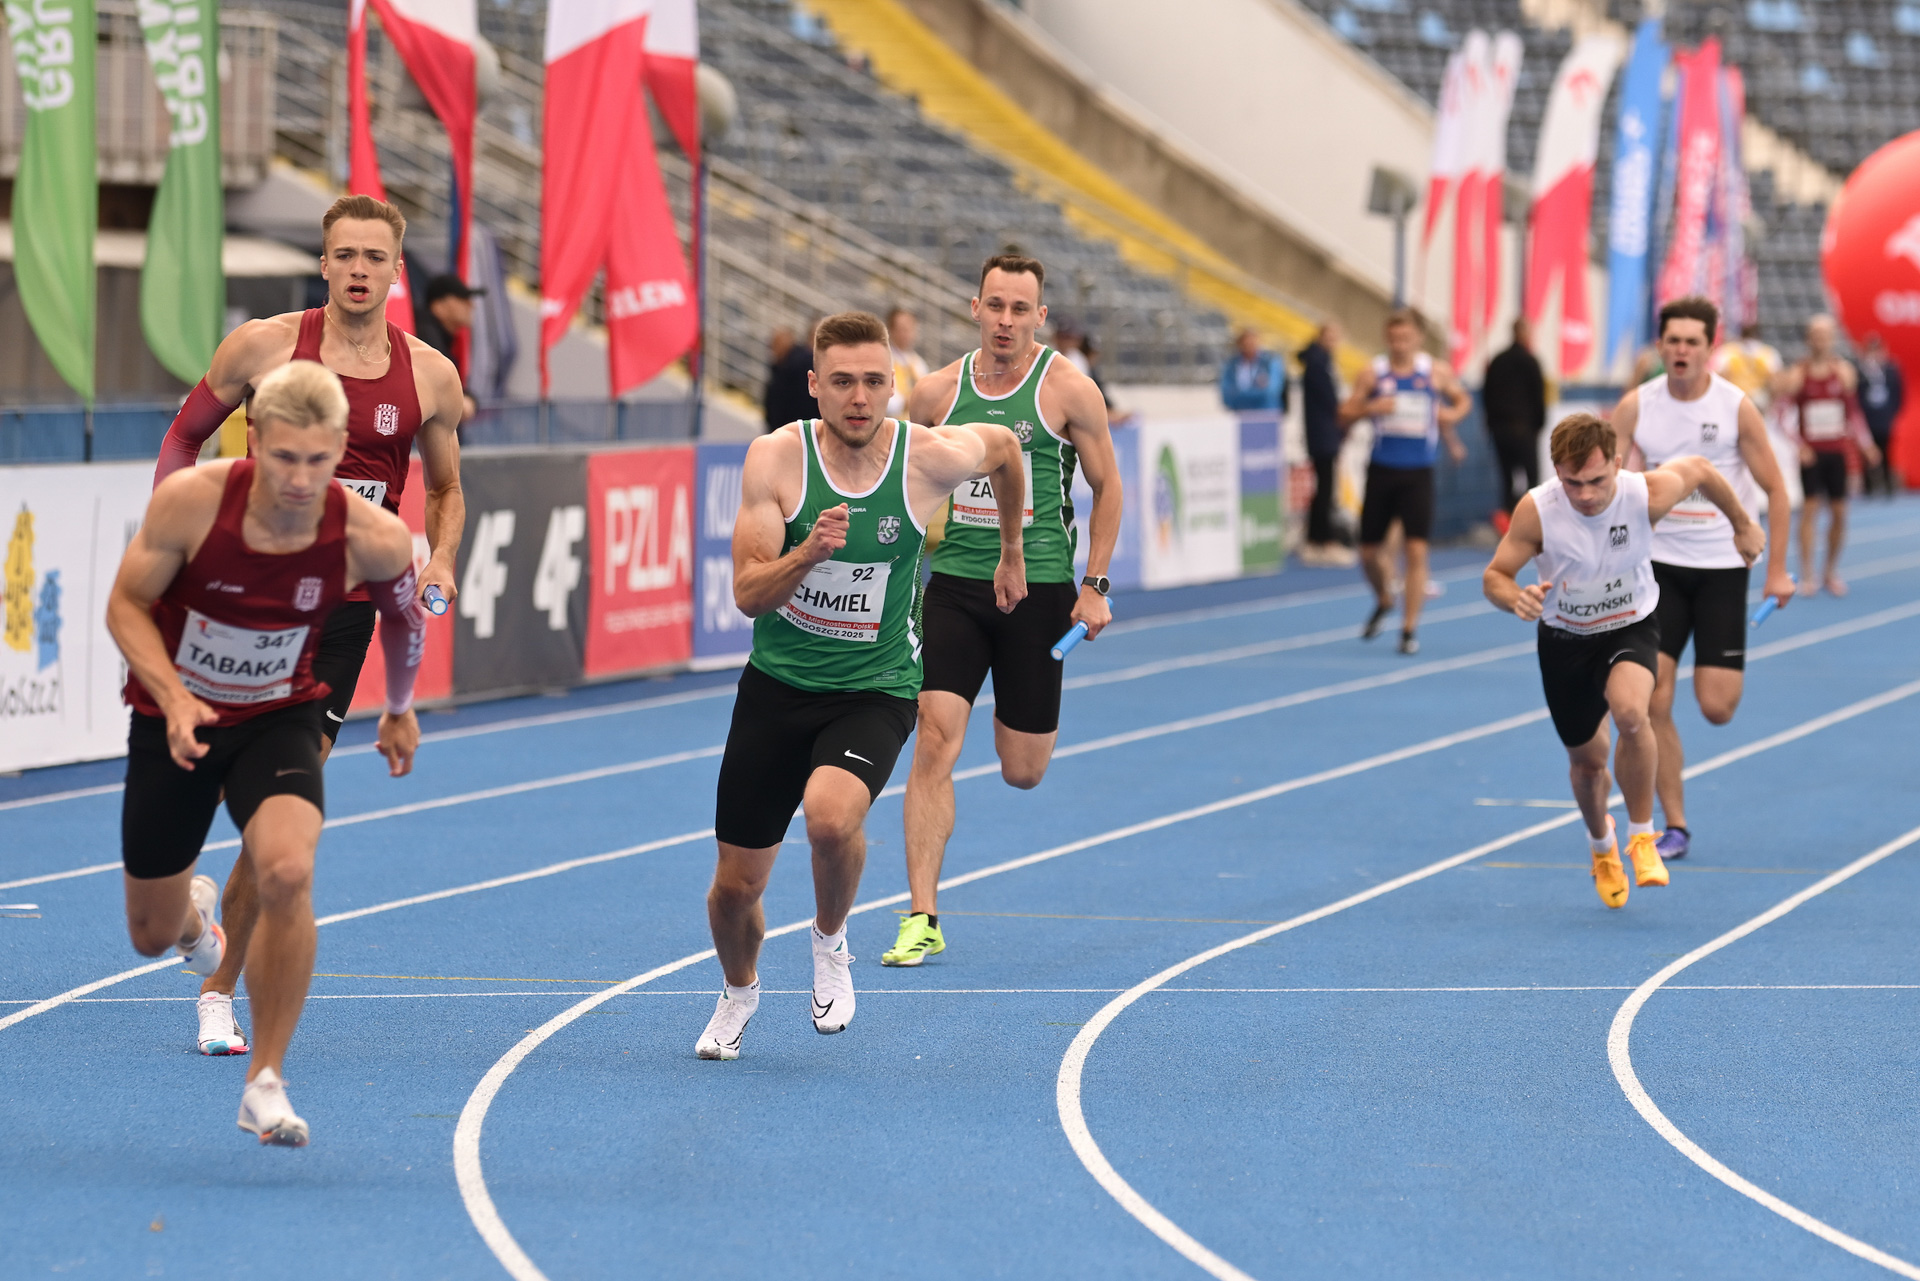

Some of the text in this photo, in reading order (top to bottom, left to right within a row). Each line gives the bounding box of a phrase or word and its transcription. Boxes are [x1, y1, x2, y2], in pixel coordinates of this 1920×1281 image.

[346, 484, 376, 502] 44
[970, 481, 993, 499] ZA
[605, 484, 693, 597] PZLA
[460, 509, 516, 639] 4F
[533, 505, 586, 631] 4F
[851, 566, 875, 583] 92
[793, 583, 871, 613] CHMIEL
[1605, 578, 1622, 593] 14
[1558, 592, 1633, 617] ŁUCZYŃSKI
[786, 611, 864, 639] BYDGOSZCZ 2025
[808, 616, 852, 629] Mistrzostwa
[852, 623, 875, 631] Polski
[255, 632, 299, 650] 347
[188, 643, 288, 678] TABAKA
